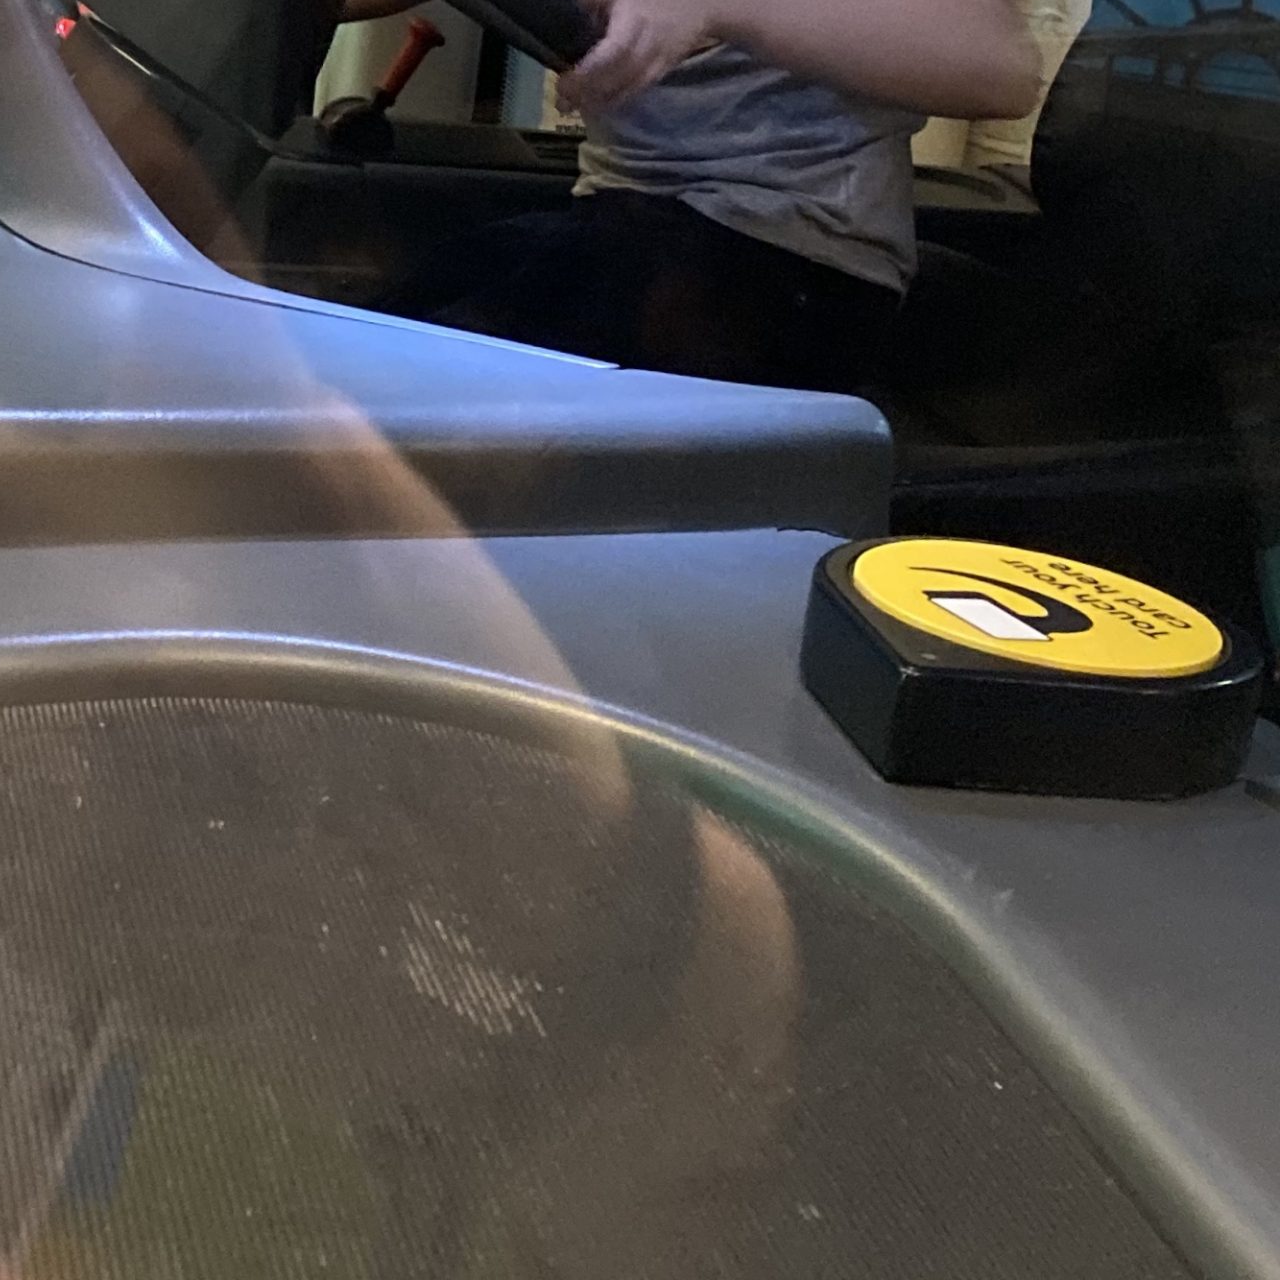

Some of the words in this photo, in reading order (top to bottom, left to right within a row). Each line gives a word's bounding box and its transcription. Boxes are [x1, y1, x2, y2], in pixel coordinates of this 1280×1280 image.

[999, 557, 1082, 591] your
[1046, 561, 1121, 594] here
[1074, 592, 1169, 639] Touch
[1113, 597, 1192, 630] card
